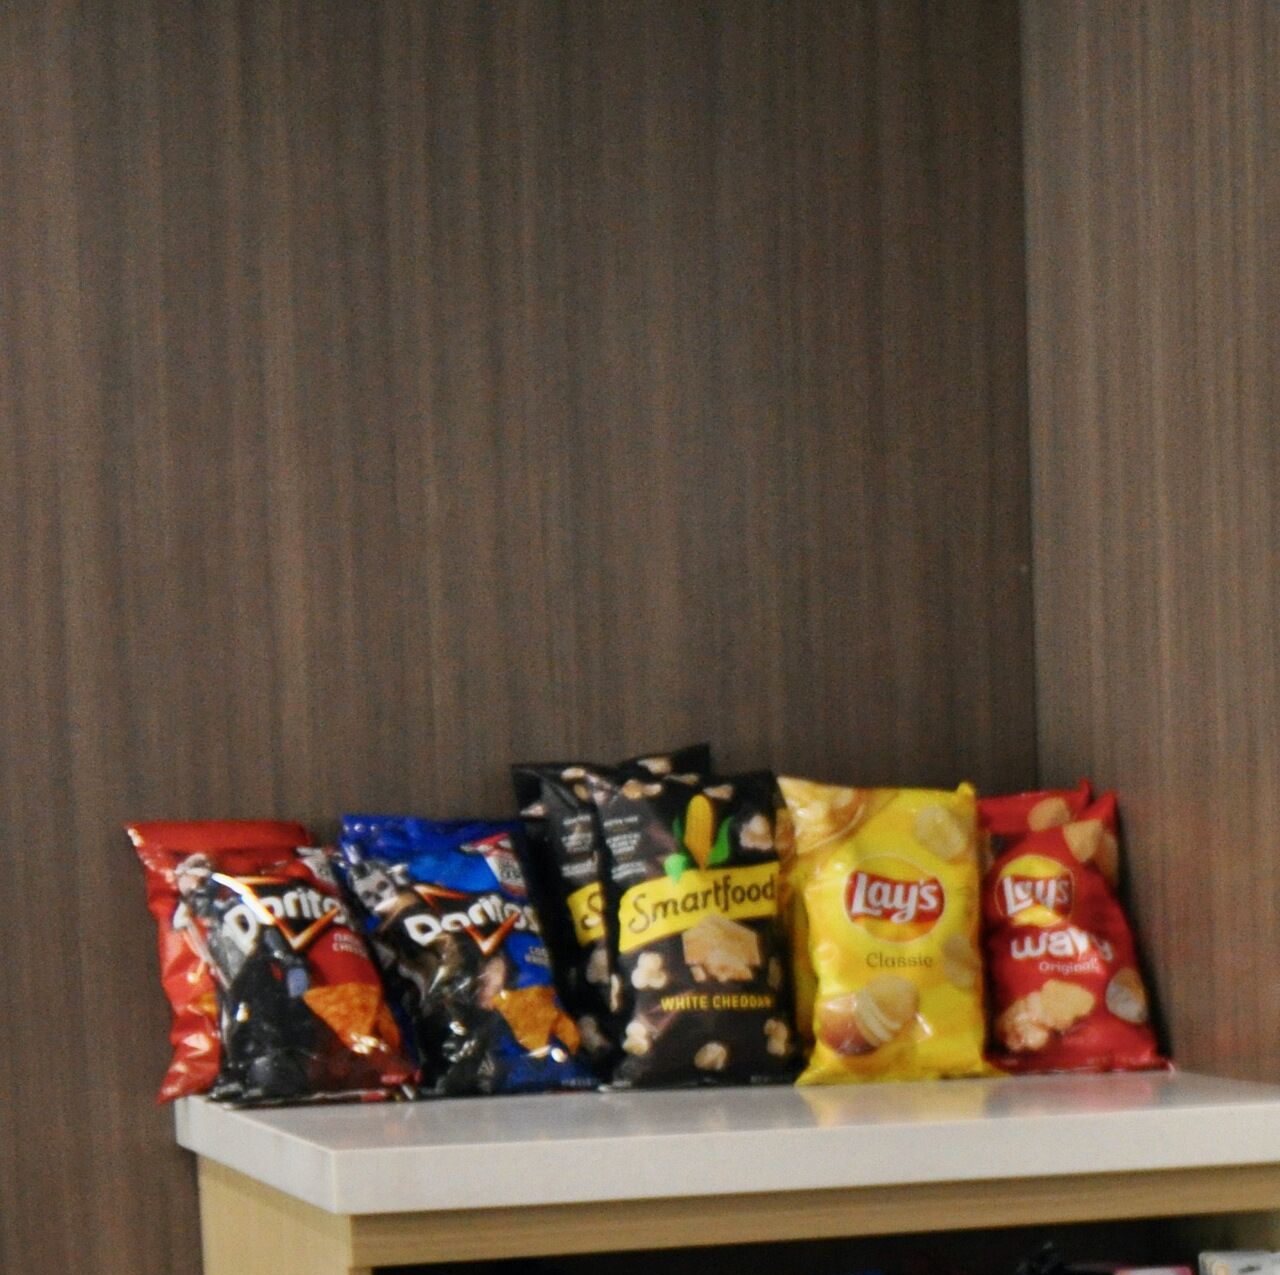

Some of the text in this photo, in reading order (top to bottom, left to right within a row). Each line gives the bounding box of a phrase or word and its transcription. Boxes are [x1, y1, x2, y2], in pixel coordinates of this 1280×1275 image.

[222, 886, 347, 953] Doritos
[403, 894, 541, 947] Doritos
[627, 872, 776, 934] Smartfood
[852, 872, 938, 924] Lay's
[866, 951, 933, 968] Classic
[660, 992, 773, 1012] WHITE CHEDDAR
